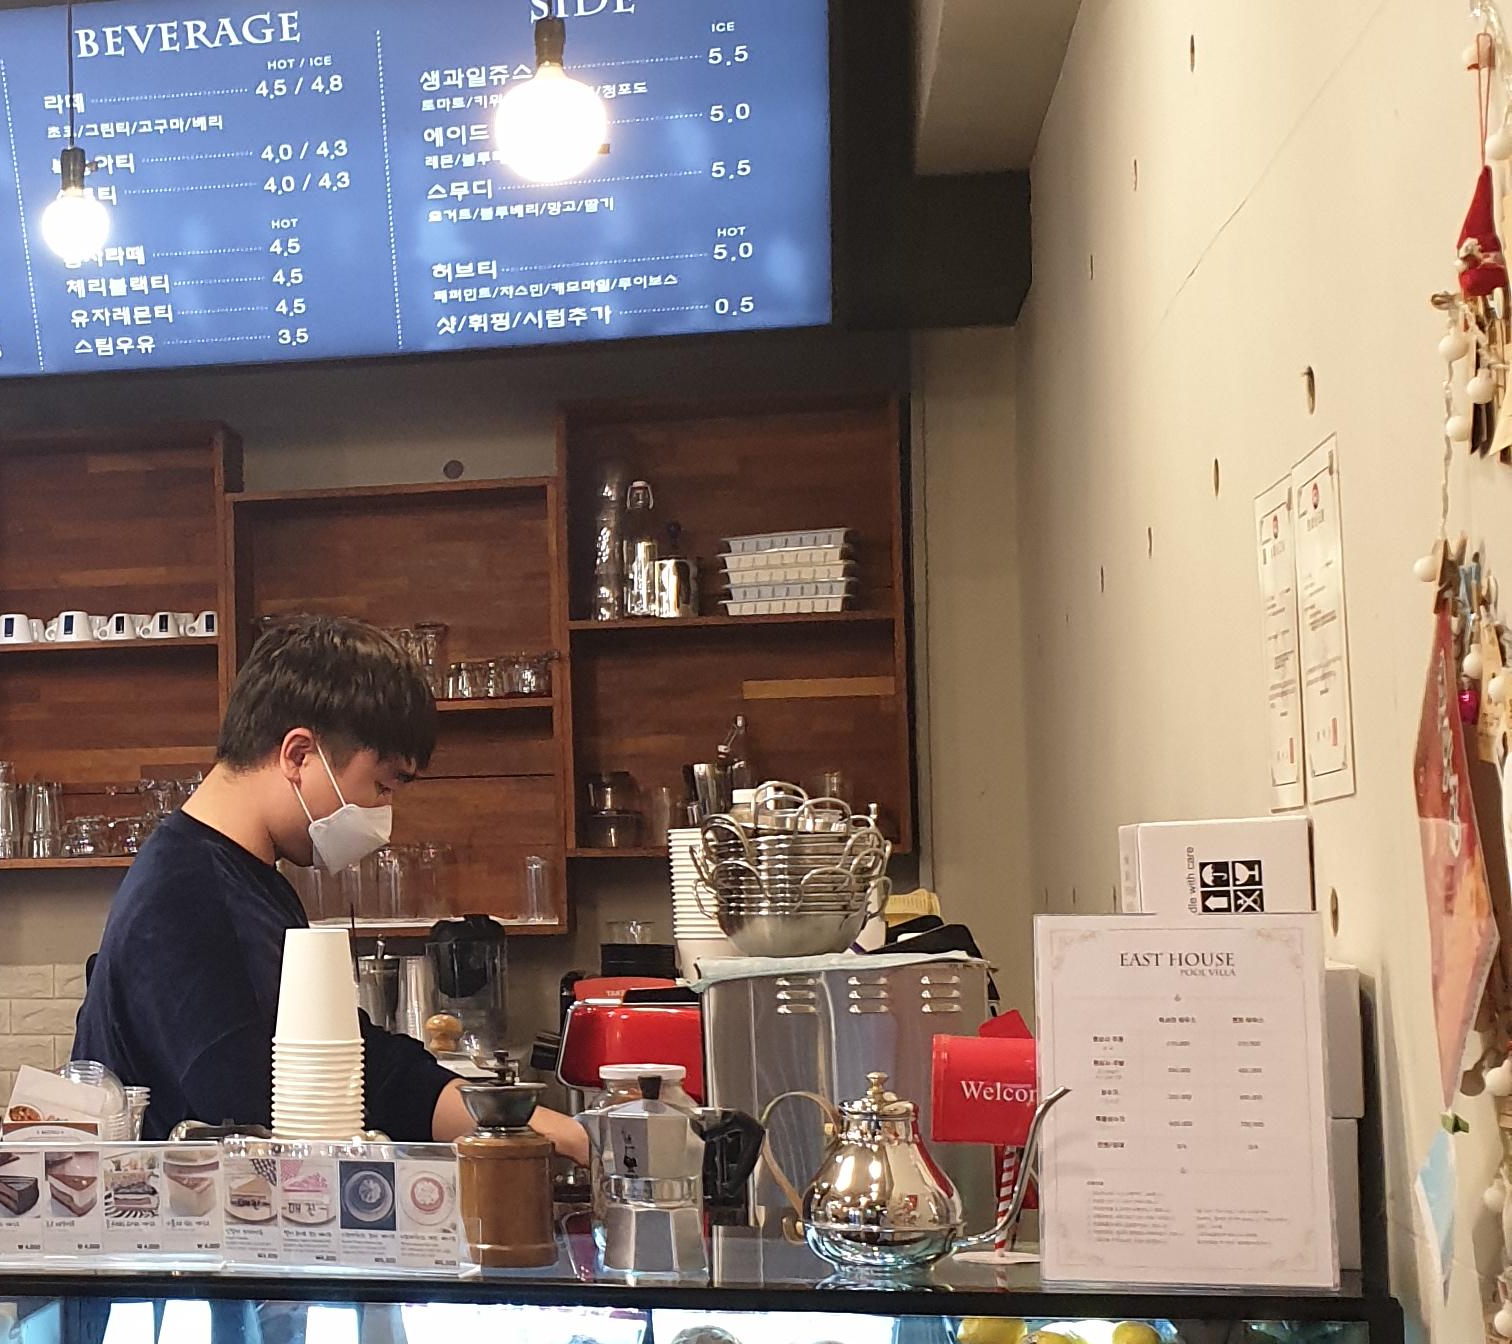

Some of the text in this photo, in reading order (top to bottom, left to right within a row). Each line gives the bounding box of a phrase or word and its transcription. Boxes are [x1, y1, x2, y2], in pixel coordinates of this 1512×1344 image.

[74, 10, 301, 58] BEVERAGE
[711, 21, 735, 33] ICE
[267, 58, 296, 70] HOT
[309, 55, 332, 67] ICE
[419, 45, 749, 91] 생과일쥬스 5.5
[255, 79, 287, 99] 4.5
[311, 74, 343, 95] 4.8
[423, 103, 750, 149] 에이드 5.0
[260, 143, 293, 164] 4.0
[316, 139, 348, 160] 4.3
[263, 175, 295, 195] 4.0
[318, 171, 350, 192] 4.3
[427, 159, 751, 202] 스무디 5.5
[271, 218, 298, 229] HOT
[717, 226, 746, 238] HOT
[269, 237, 301, 257] 4.5
[431, 242, 753, 283] 허브티 5.0
[272, 268, 303, 287] 4.5
[70, 298, 306, 328] 유자레몬티 4.5
[436, 296, 754, 335] 샷/휘핑/시럽추가 0.5
[278, 327, 309, 346] 3.5
[1119, 952, 1236, 967] EAST HOUSE
